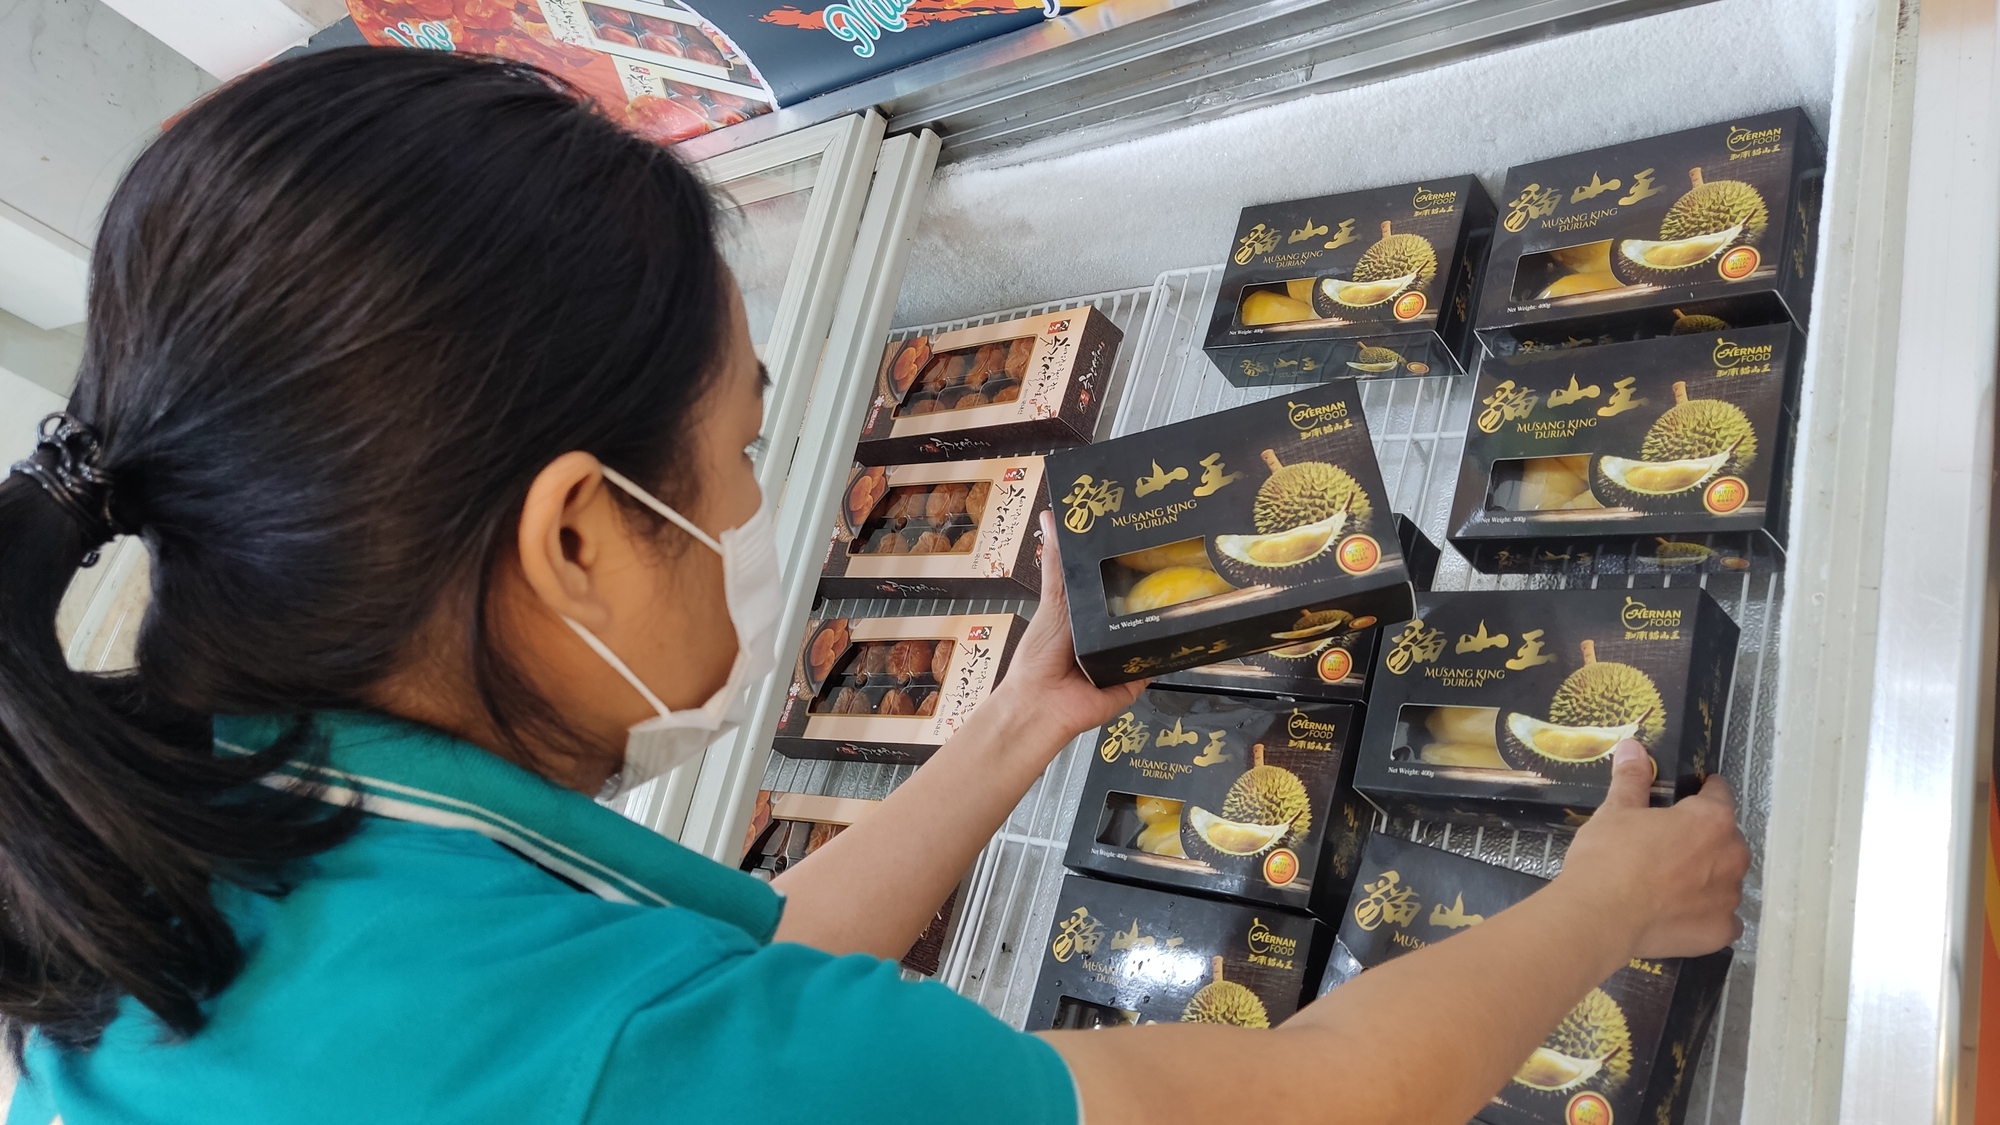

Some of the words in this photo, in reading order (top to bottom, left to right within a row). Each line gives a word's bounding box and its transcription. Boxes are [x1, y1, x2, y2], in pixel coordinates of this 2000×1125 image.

[1730, 128, 1782, 144] HERNAN
[1753, 135, 1780, 145] FOOD
[1416, 191, 1457, 202] HERNAN
[1433, 198, 1455, 206] FOOD
[1541, 213, 1588, 229] MUSANG
[1590, 208, 1618, 219] KING
[1558, 220, 1597, 232] DURIAN
[1263, 253, 1300, 264] MUSANG
[1301, 250, 1323, 260] KING
[1276, 259, 1306, 268] DURIAN
[1717, 344, 1772, 358] HERNAN
[1741, 353, 1771, 363] FOOD
[1293, 400, 1346, 421] HERNAN
[1319, 409, 1348, 422] FOOD
[1517, 421, 1565, 433] MUSANG
[1568, 418, 1597, 431] KING
[1535, 429, 1576, 439] DURIAN
[1111, 507, 1164, 528] MUSANG
[1167, 499, 1198, 515] KING
[1133, 514, 1178, 531] DURIAN
[1625, 607, 1682, 619] HERNAN
[1650, 618, 1680, 626] FOOD
[1425, 667, 1473, 678] MUSANG
[1476, 668, 1505, 680] KING
[1443, 678, 1483, 688] DURIAN
[1291, 719, 1335, 732] HERNAN
[1309, 730, 1333, 739] FOOD
[1129, 757, 1167, 771] MUSANG
[1169, 763, 1193, 774] KING
[1142, 769, 1175, 780] DURIAN
[1251, 931, 1297, 948] HERNAN
[1270, 944, 1294, 956] FOOD
